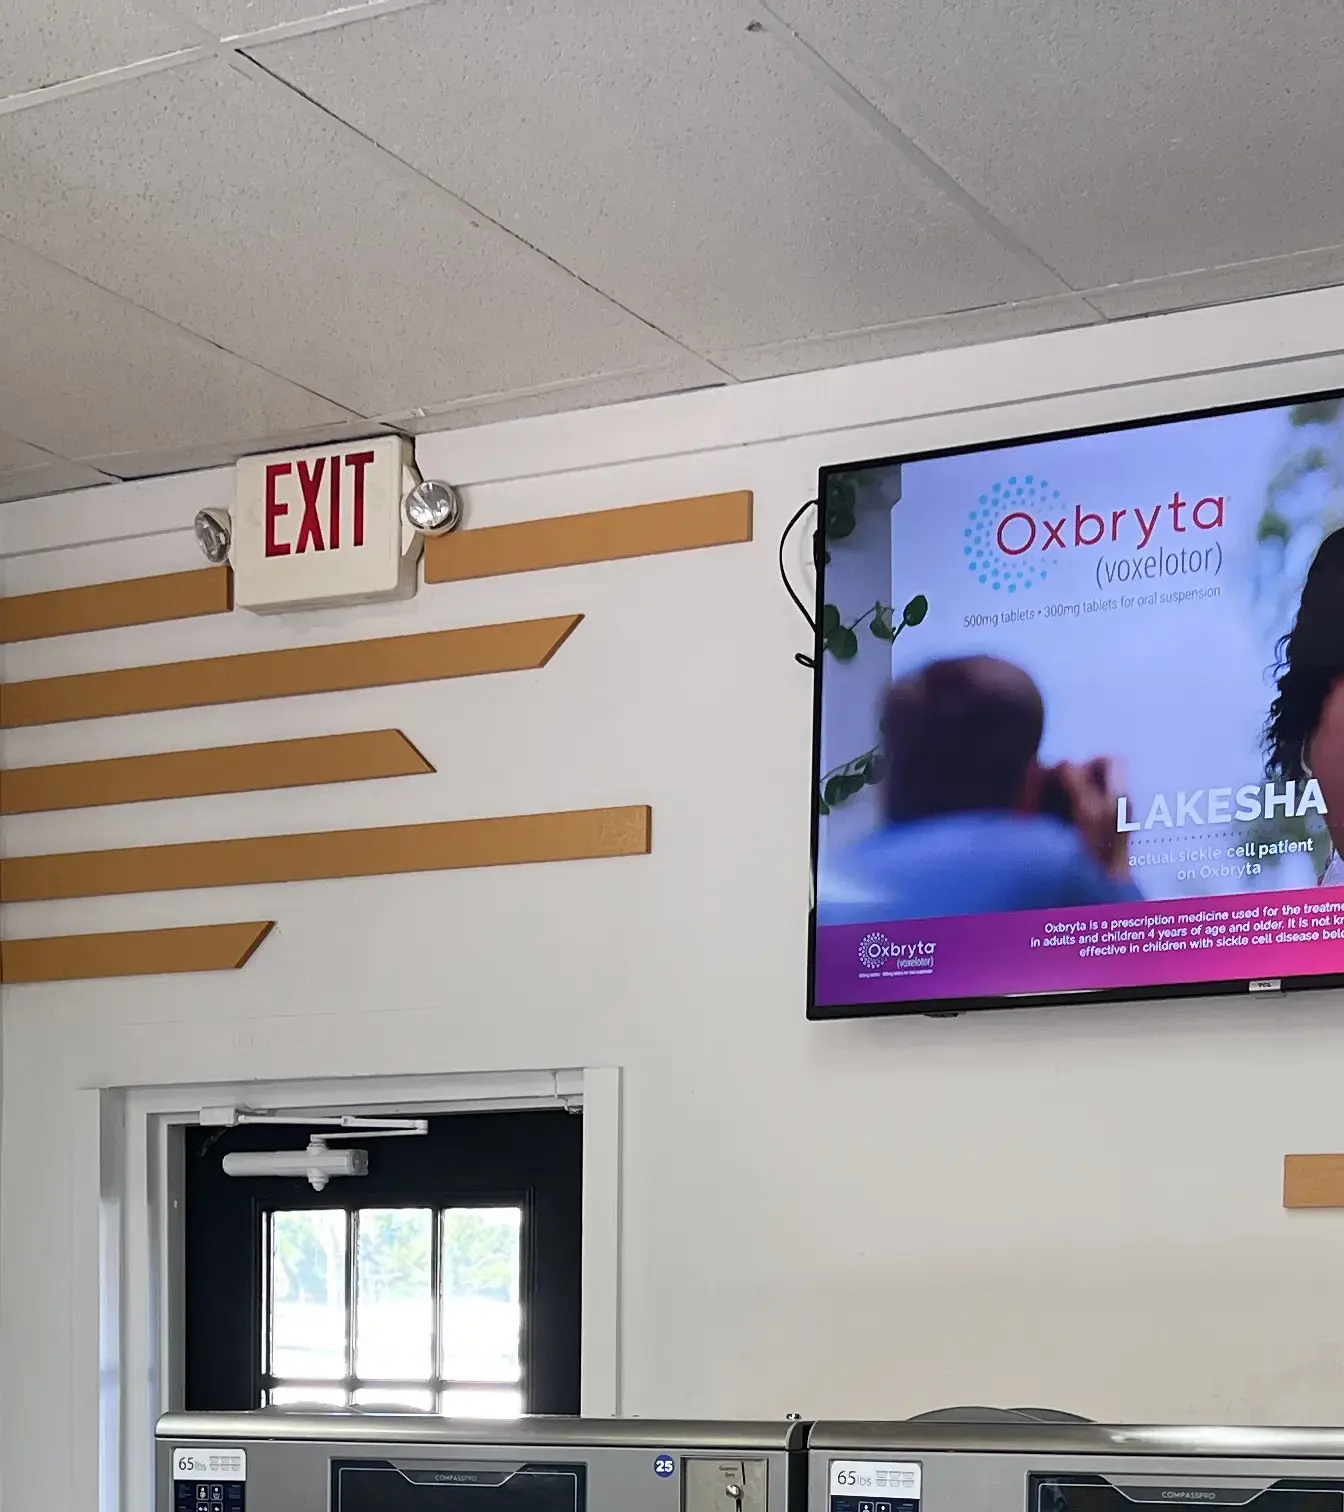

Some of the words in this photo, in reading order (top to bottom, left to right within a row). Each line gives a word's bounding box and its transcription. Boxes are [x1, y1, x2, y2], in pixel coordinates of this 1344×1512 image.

[265, 451, 374, 558] EXIT
[996, 491, 1224, 556] Oxbryta
[1096, 541, 1223, 590] (voxelotor)
[963, 613, 998, 628] 500mg
[1001, 608, 1035, 624] tablets
[1044, 603, 1080, 618] 300mg
[1082, 598, 1118, 612] tablets
[1120, 595, 1135, 608] for
[1137, 592, 1157, 606] oral
[1159, 585, 1221, 605] suspension
[1117, 778, 1328, 832] LAKESHA
[1128, 853, 1173, 867] actual
[1179, 848, 1221, 863] sickle
[1227, 842, 1256, 859] cell
[1259, 837, 1314, 859] patient
[1177, 869, 1196, 881] on
[1200, 862, 1262, 880] Oxbryta
[1030, 937, 1040, 948] in
[1043, 934, 1076, 948] adults
[1078, 932, 1099, 944] and
[1100, 929, 1145, 943] children
[1147, 929, 1155, 939] 4
[1157, 926, 1187, 942] years
[1190, 924, 1203, 936] of
[1204, 924, 1227, 937] age
[1228, 921, 1250, 933] and
[1253, 918, 1284, 931] older.
[1288, 918, 1296, 929] It
[1298, 916, 1308, 928] is
[1311, 915, 1331, 927] not
[1044, 921, 1087, 935] Oxbryta
[1089, 919, 1098, 931] is
[1100, 921, 1108, 930] a
[1111, 914, 1175, 932] prescription
[1178, 910, 1229, 925] medicine
[1231, 907, 1260, 920] used
[1263, 905, 1278, 917] for
[1281, 904, 1301, 916] the
[868, 940, 936, 959] Oxbryta
[1079, 944, 1127, 957] effective
[1129, 942, 1140, 953] in
[1142, 938, 1187, 952] children
[1190, 936, 1213, 949] with
[1216, 934, 1249, 947] sickle
[1251, 932, 1273, 945] cell
[1275, 930, 1319, 943] disease
[434, 1474, 477, 1482] COMPASSPRO
[656, 1460, 674, 1473] 25
[1161, 1490, 1216, 1500] COMPASSPRO
